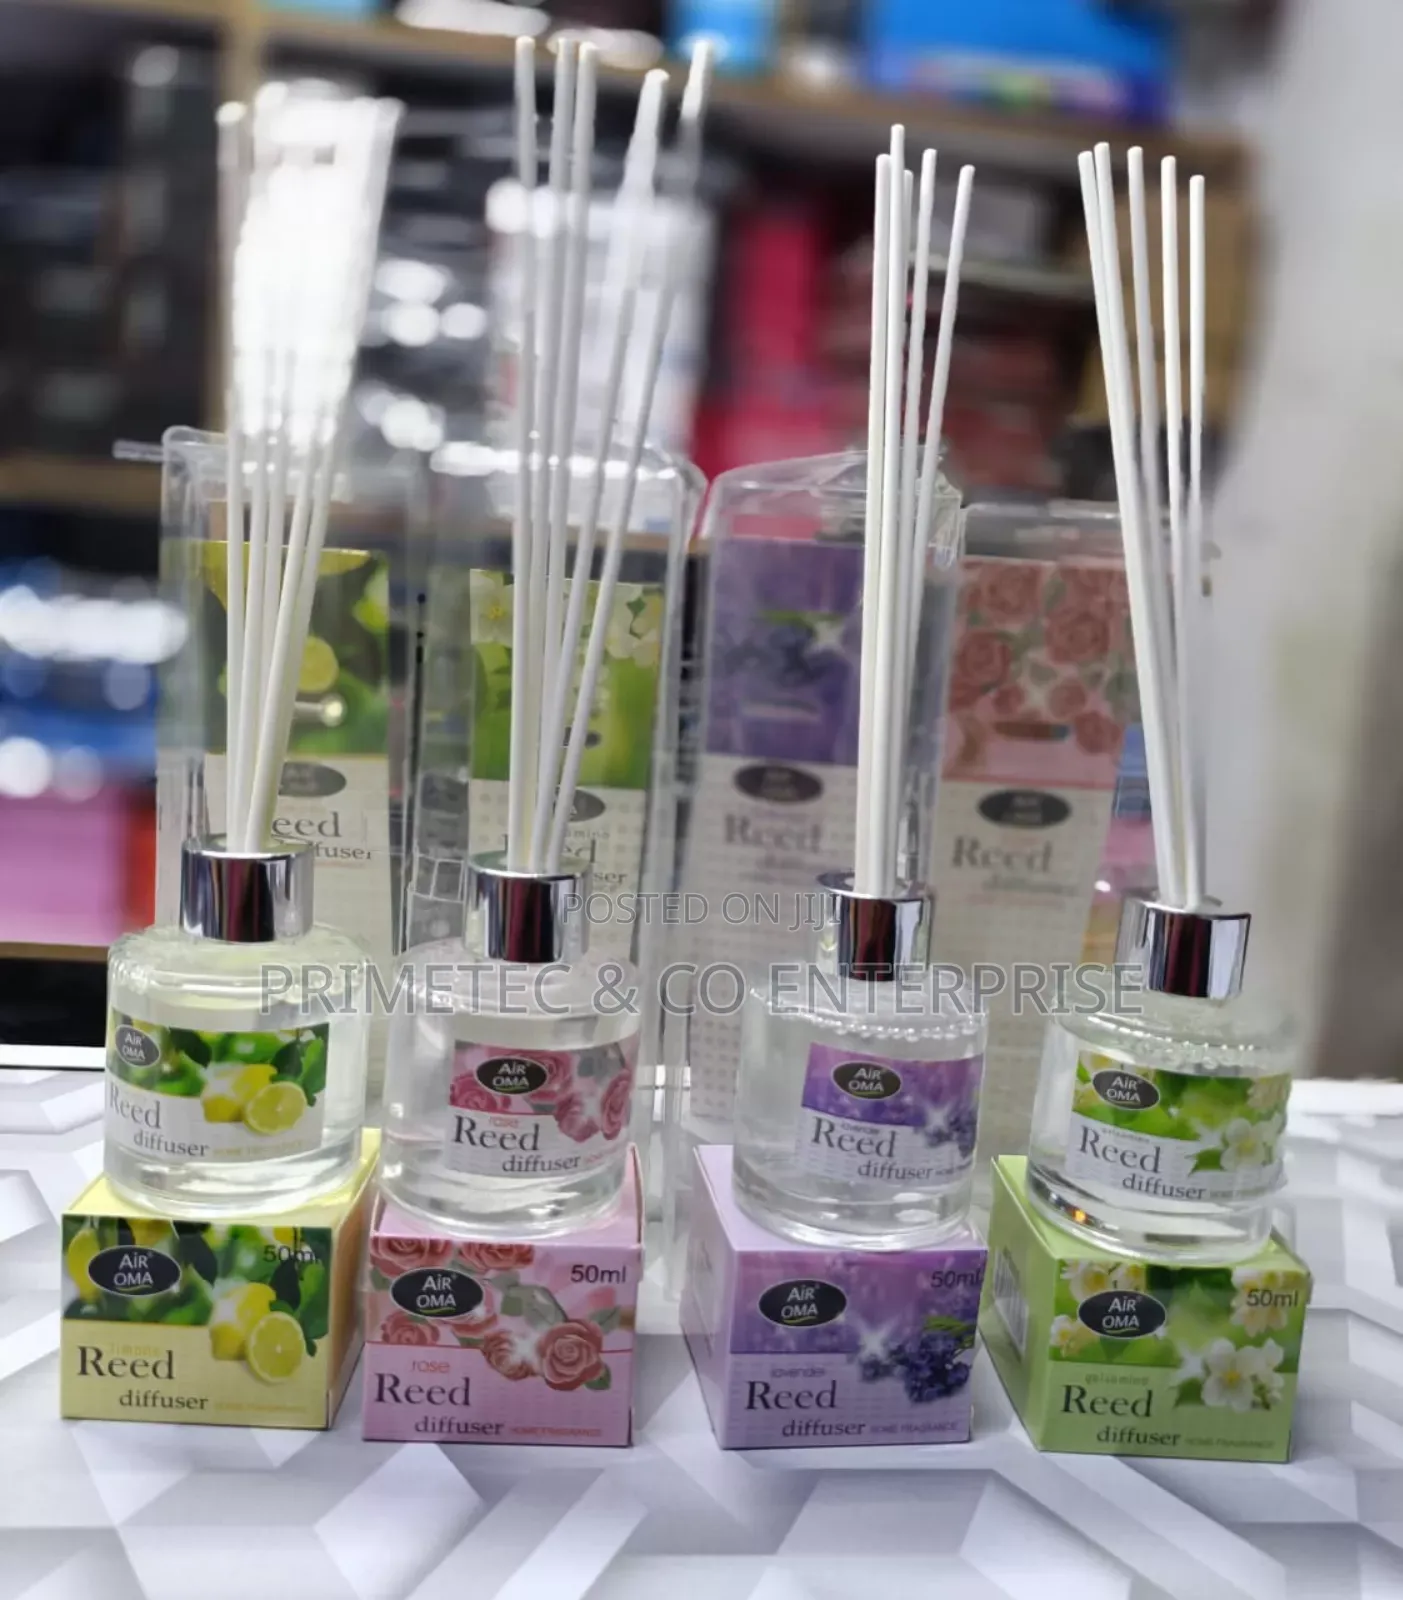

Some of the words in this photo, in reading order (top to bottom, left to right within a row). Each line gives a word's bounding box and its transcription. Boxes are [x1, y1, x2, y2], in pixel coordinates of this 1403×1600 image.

[271, 811, 342, 838] eed
[122, 1046, 146, 1060] OMA
[492, 1075, 530, 1087] OMA
[848, 1080, 885, 1092] OMA
[109, 1081, 161, 1129] Reed
[1106, 1088, 1141, 1103] OMA
[453, 1114, 541, 1151] Reed
[811, 1115, 899, 1158] Reed
[133, 1129, 209, 1157] diffuser
[1079, 1124, 1162, 1174] Reed
[501, 1154, 581, 1172] diffuser
[857, 1159, 934, 1180] diffuser
[1122, 1173, 1207, 1199] diffuser
[118, 1252, 149, 1269] AiR
[113, 1271, 154, 1287] OMA
[421, 1276, 452, 1292] AiR
[570, 1264, 628, 1285] 50ml
[416, 1293, 456, 1309] OMA
[787, 1287, 816, 1303] AiR
[1107, 1296, 1137, 1313] AiR
[1246, 1288, 1300, 1308] 50ml
[780, 1302, 818, 1318] OMA
[1102, 1314, 1140, 1329] OMA
[77, 1345, 175, 1380] Reed
[411, 1359, 450, 1374] rose
[118, 1389, 209, 1411] diffuser
[373, 1373, 472, 1407] Reed
[744, 1379, 838, 1411] Reed
[1060, 1384, 1154, 1418] Reed
[413, 1416, 505, 1436] diffuser
[781, 1419, 866, 1437] diffuser
[1096, 1426, 1181, 1446] diffuser
